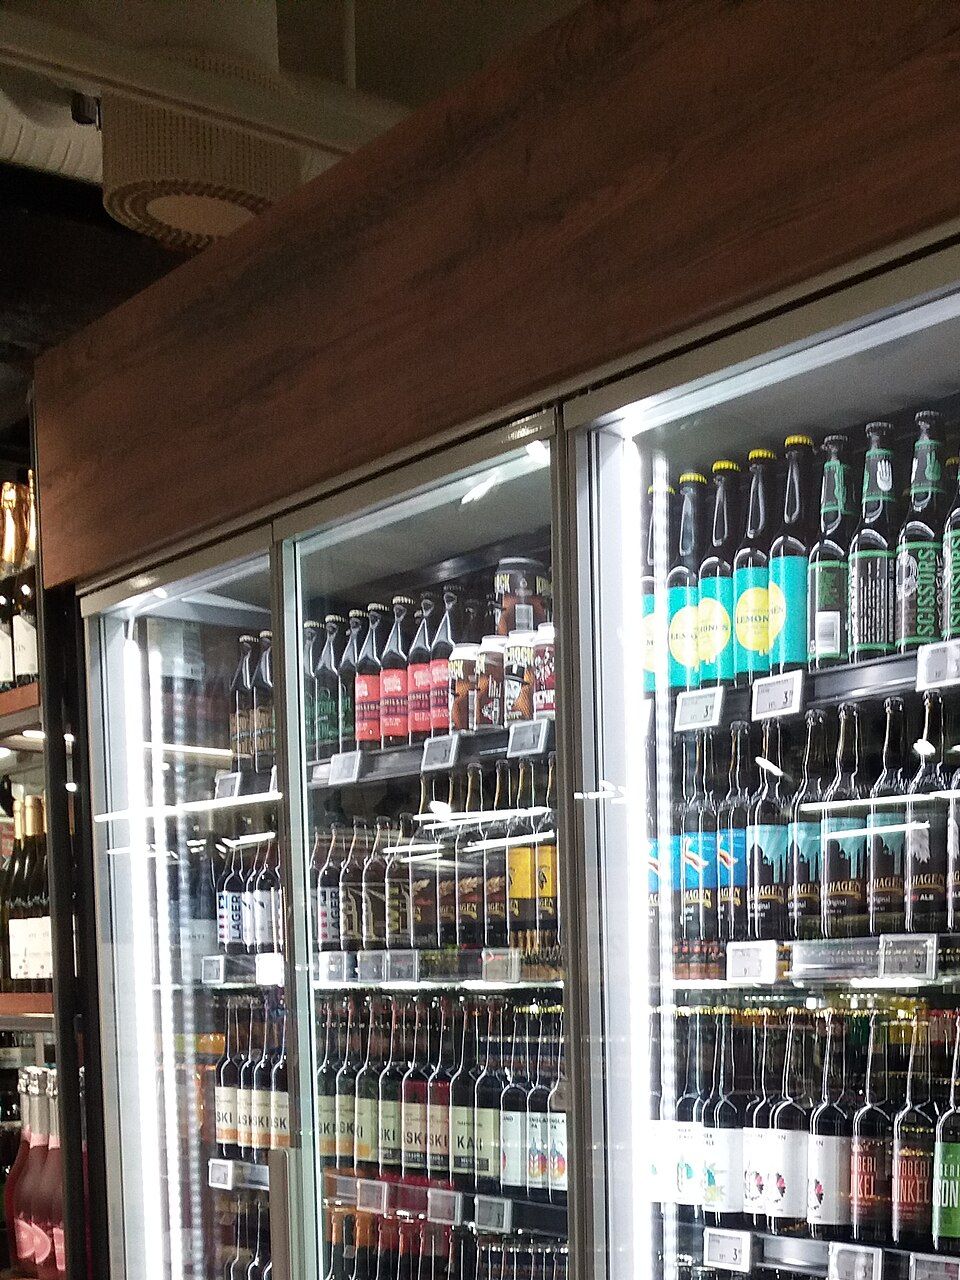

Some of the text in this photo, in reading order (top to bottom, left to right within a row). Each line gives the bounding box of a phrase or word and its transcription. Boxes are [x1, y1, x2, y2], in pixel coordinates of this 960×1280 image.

[917, 548, 936, 636] SCISSORS
[736, 614, 769, 624] LEMON
[231, 895, 241, 939] LAGER
[330, 890, 340, 939] LAGER
